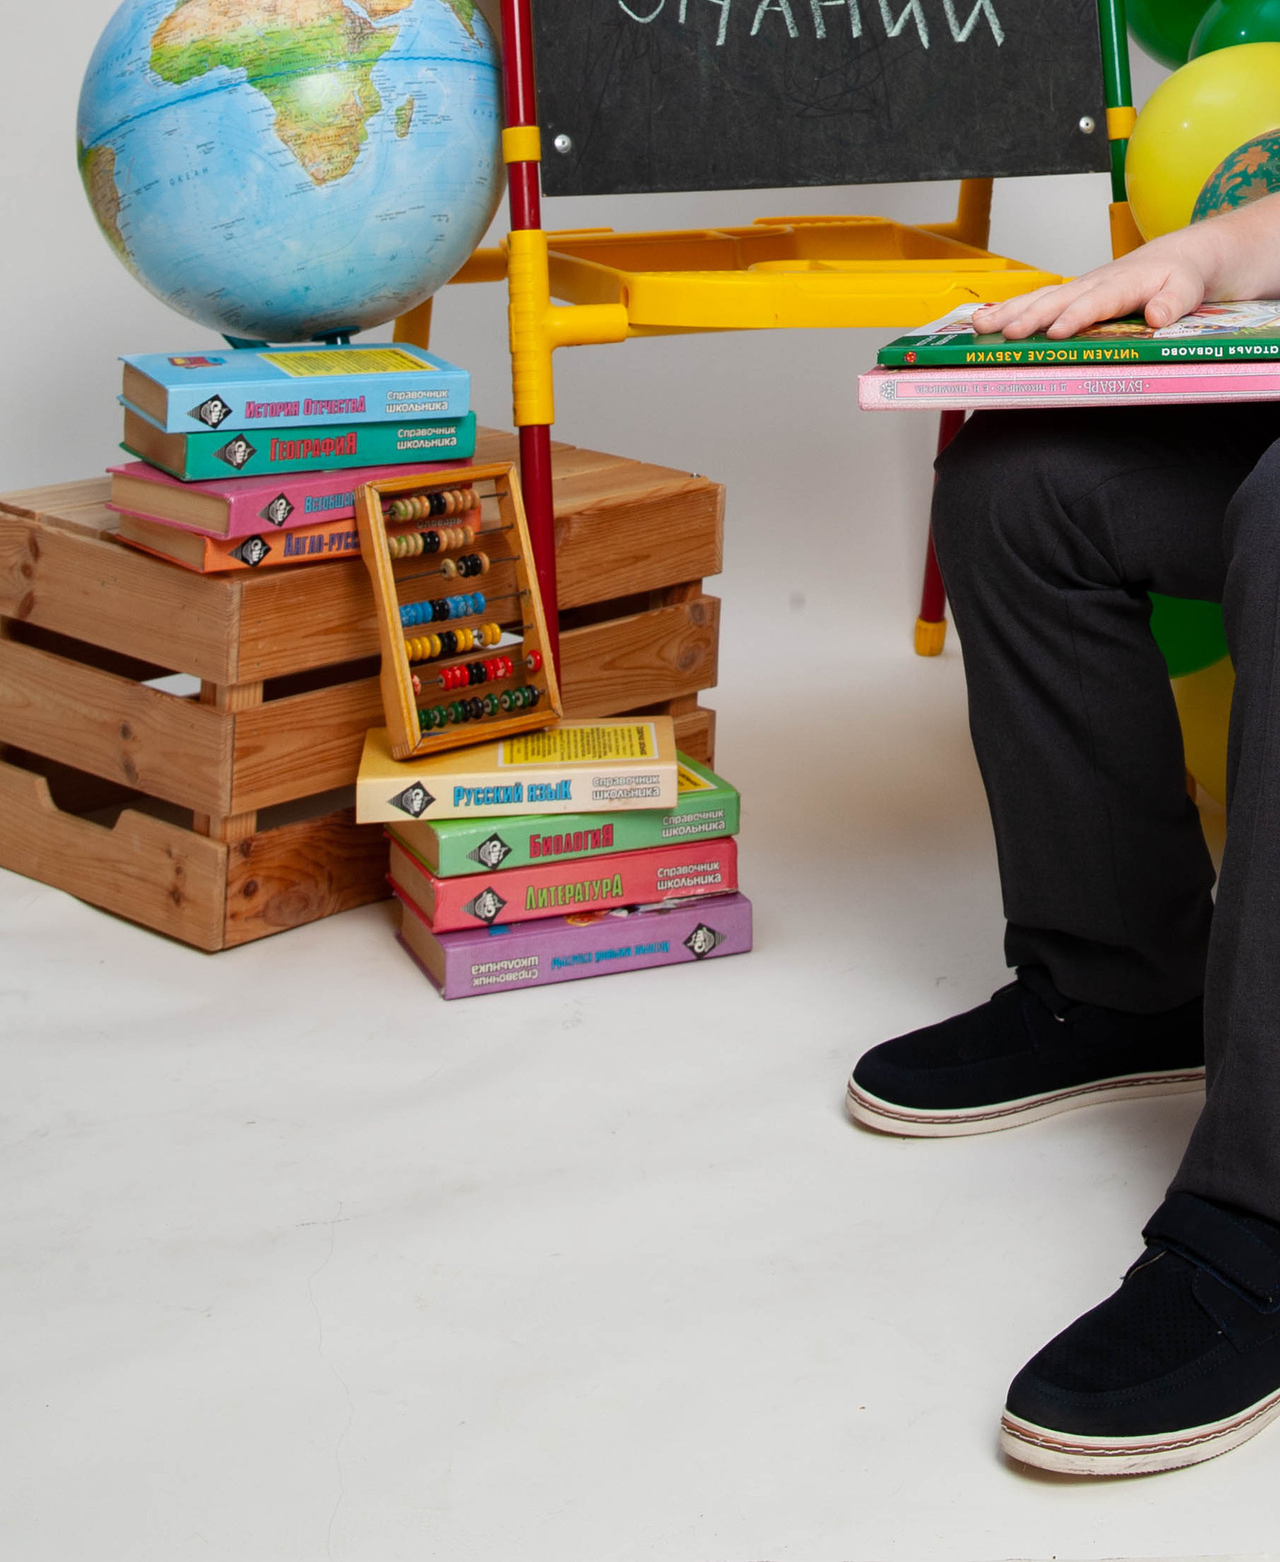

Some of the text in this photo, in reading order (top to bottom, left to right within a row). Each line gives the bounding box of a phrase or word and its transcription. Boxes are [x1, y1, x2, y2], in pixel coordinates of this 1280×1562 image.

[966, 347, 1139, 363] ЧИТАЕМ ПОСЛЕ АЗБУКИ
[1161, 345, 1224, 358] Павлова
[1082, 379, 1144, 394] БУКВАРЬ
[385, 389, 449, 402] Справочник
[245, 396, 366, 419] ИСТОРИЯ ОТЕЧЕСТВА
[385, 400, 448, 414] школьника
[397, 424, 456, 439] Справочник
[270, 432, 357, 461] ГЕОГРАФИЯ
[396, 436, 457, 450] школьника
[592, 774, 660, 788] Справочник
[453, 780, 572, 807] РУССКИЙ ЯЗЫК
[591, 786, 661, 801] школьника
[662, 809, 725, 826] Справочник
[662, 819, 726, 838] школьника
[529, 824, 614, 859] БИОЛОГИЯ
[657, 861, 720, 879] Справочник
[656, 873, 722, 891] школьника
[525, 874, 623, 911] ЛИТЕРАТУРА
[471, 956, 539, 974] школьника
[472, 970, 539, 988] Справочник
